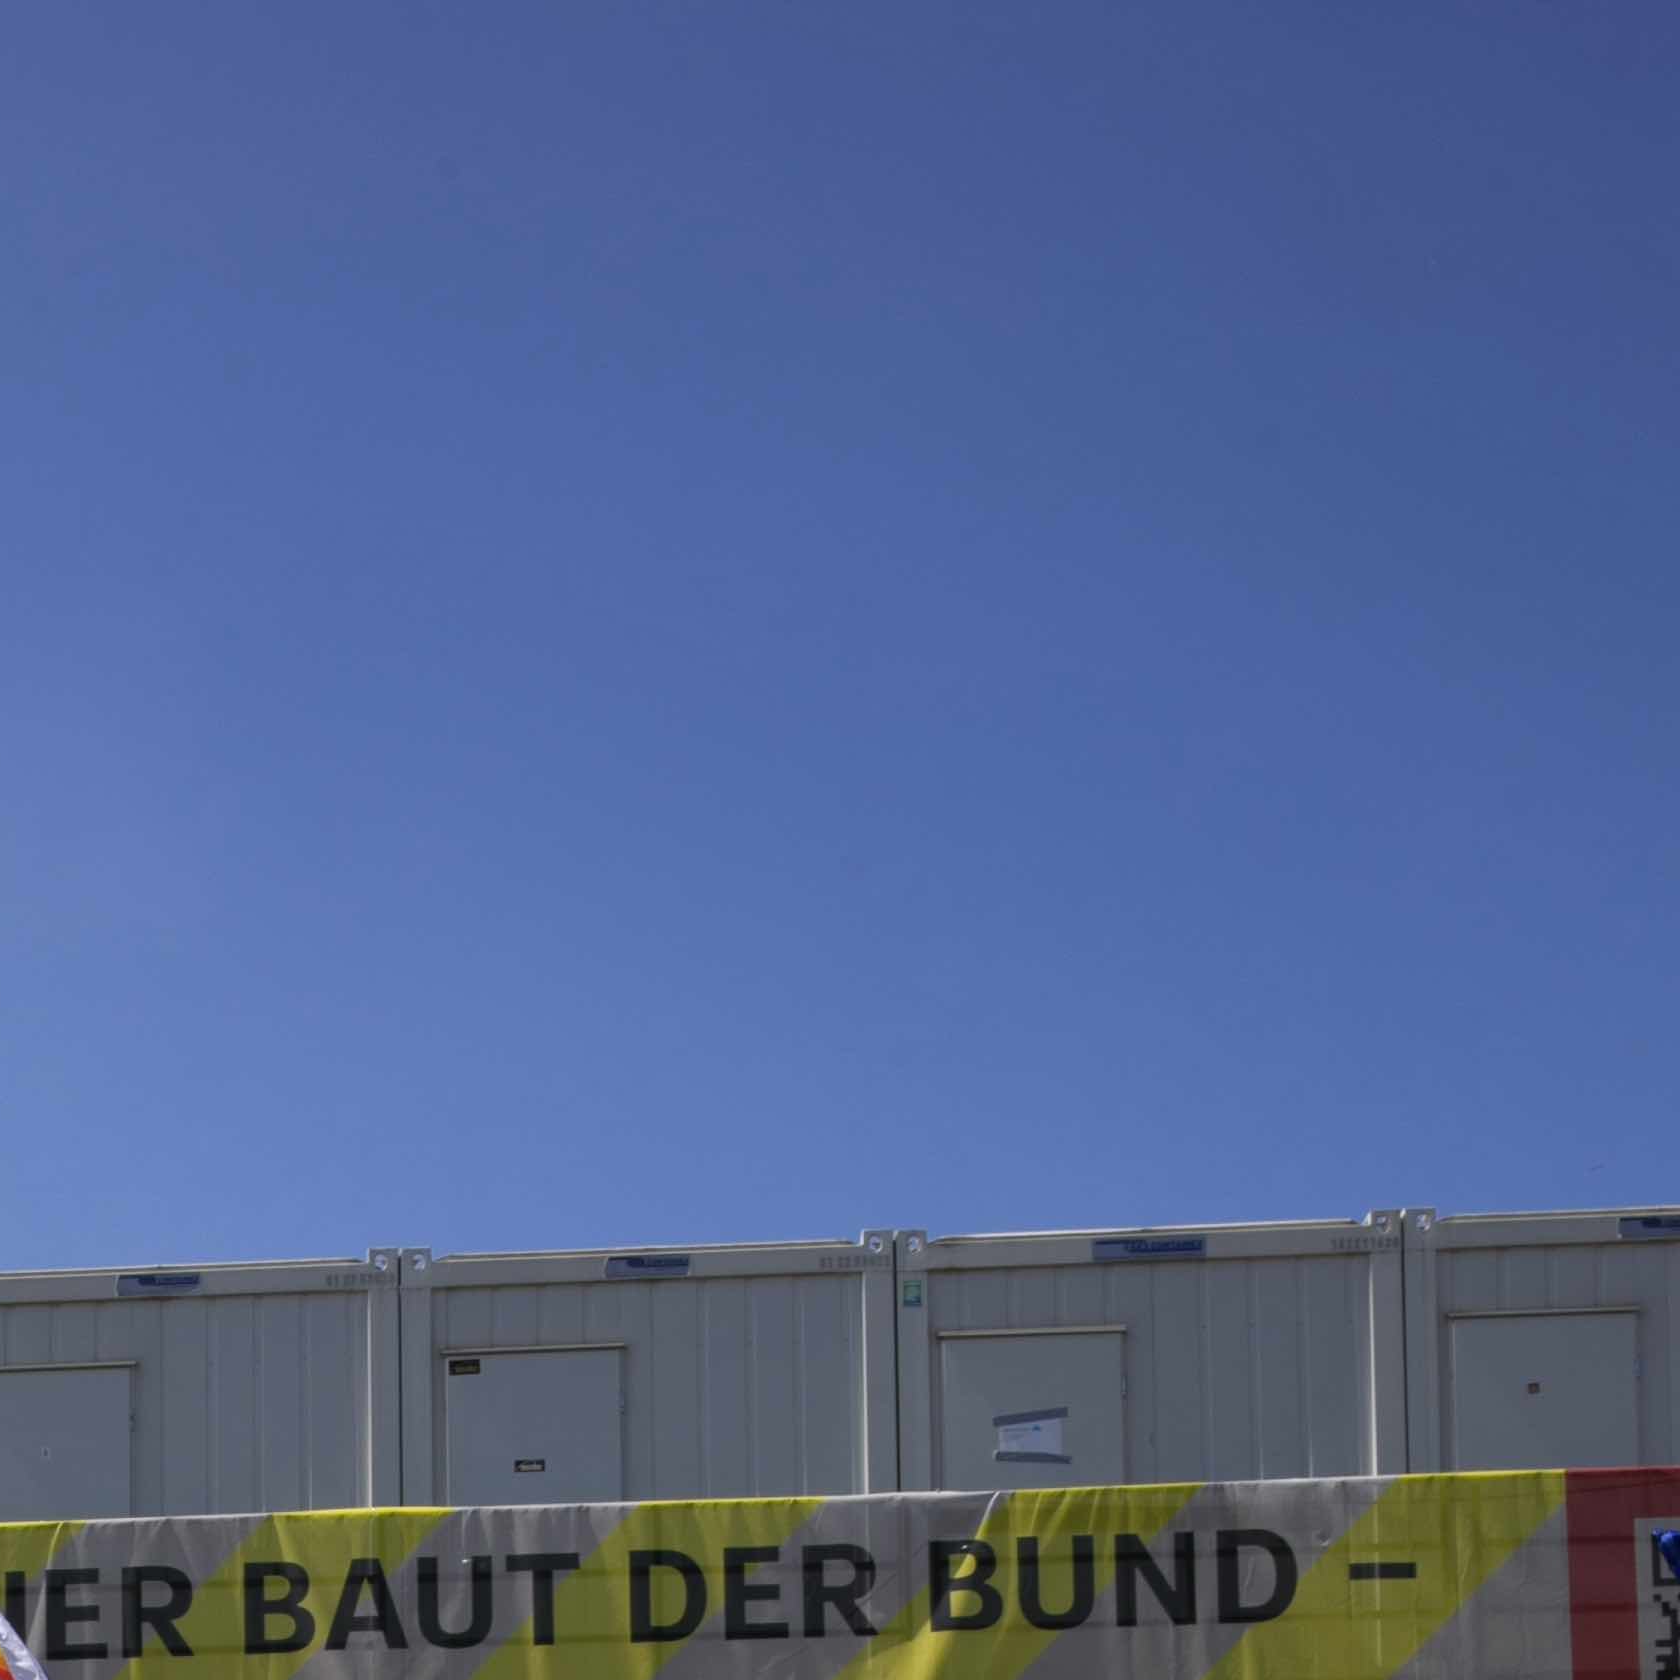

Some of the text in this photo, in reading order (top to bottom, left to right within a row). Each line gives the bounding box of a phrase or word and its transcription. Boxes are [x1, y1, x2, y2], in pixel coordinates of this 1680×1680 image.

[243, 1551, 581, 1655] BAUT
[629, 1541, 878, 1645] DER
[928, 1527, 1299, 1634] BUND
